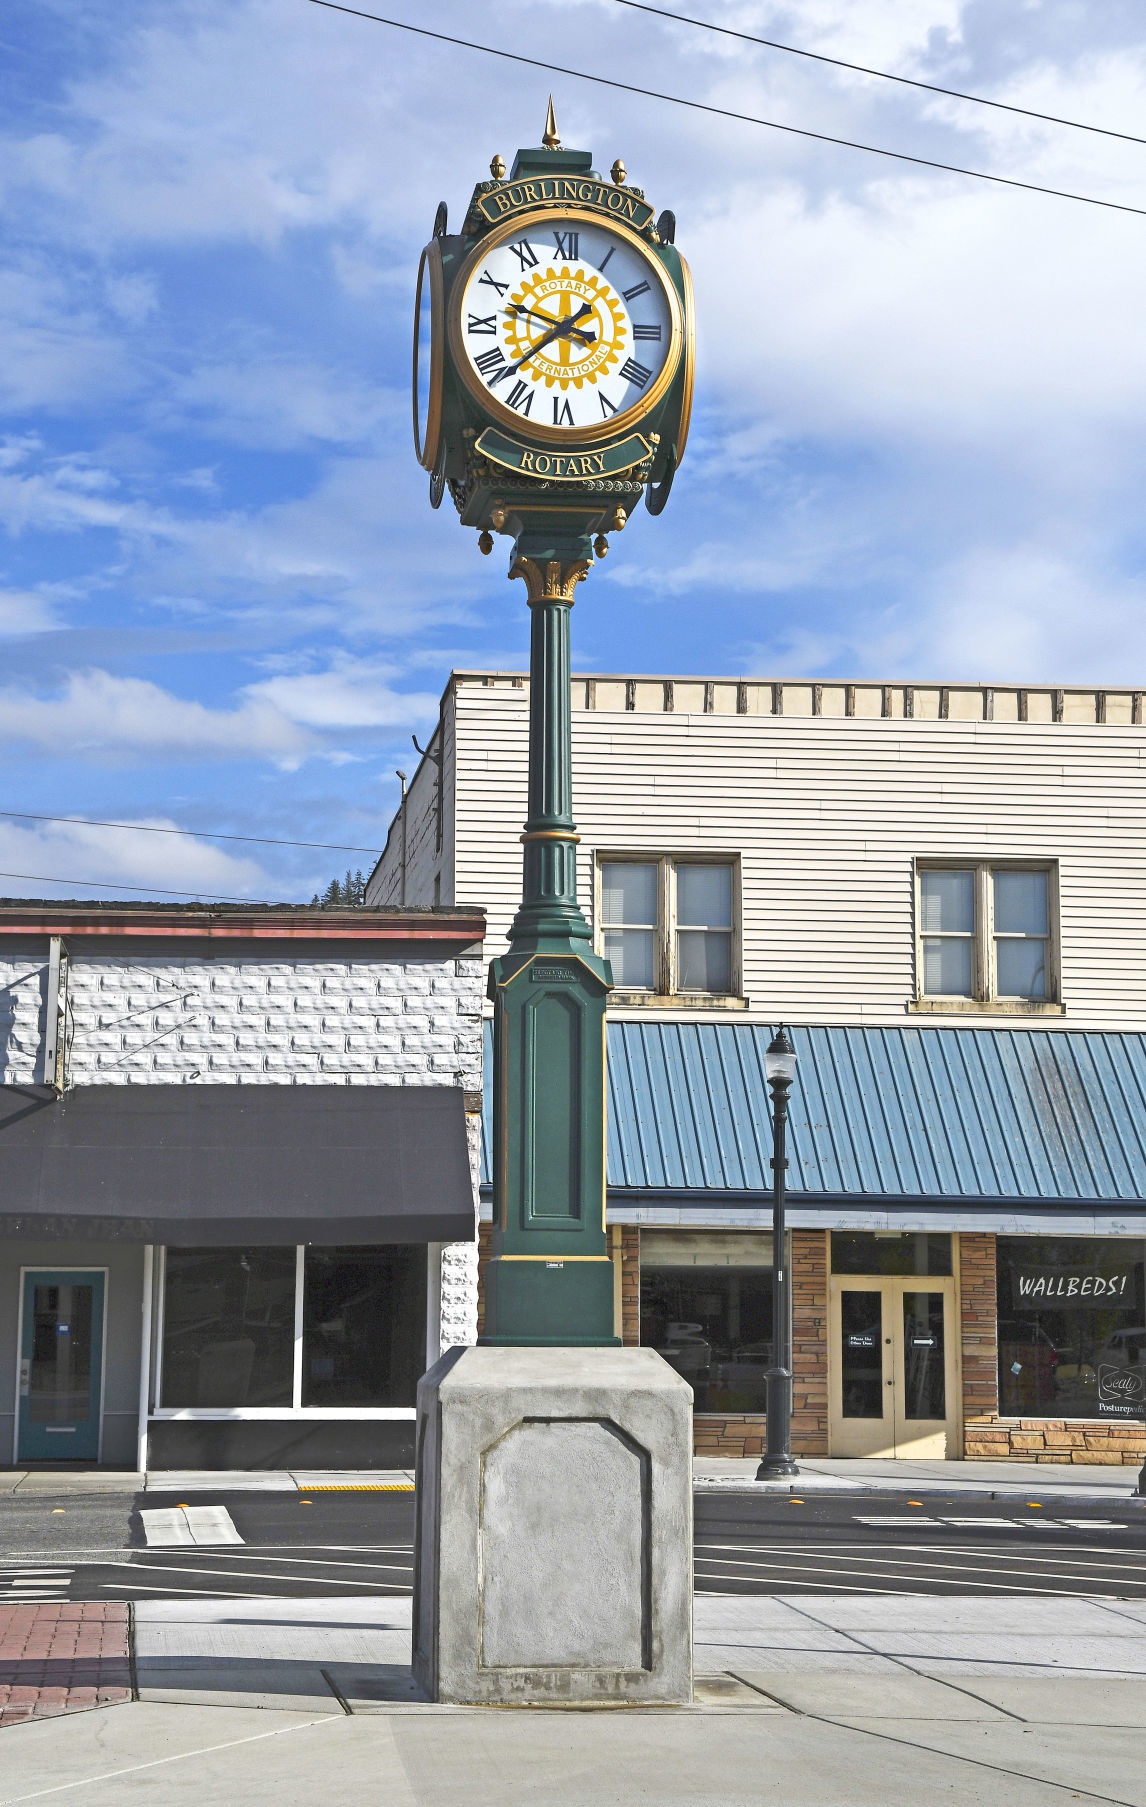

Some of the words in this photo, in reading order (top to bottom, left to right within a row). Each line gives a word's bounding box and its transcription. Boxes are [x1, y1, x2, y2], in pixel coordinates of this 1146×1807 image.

[493, 180, 640, 219] BURLINGTON
[508, 238, 540, 272] XI
[552, 231, 580, 261] XII
[478, 270, 510, 297] X
[539, 280, 591, 295] ROTARY
[467, 313, 497, 336] IX
[522, 346, 609, 377] ITERNATIONAL
[552, 396, 575, 426] VI
[598, 390, 619, 418] V
[520, 451, 607, 475] ROTARY
[1019, 1275, 1127, 1297] WALLBEDS!
